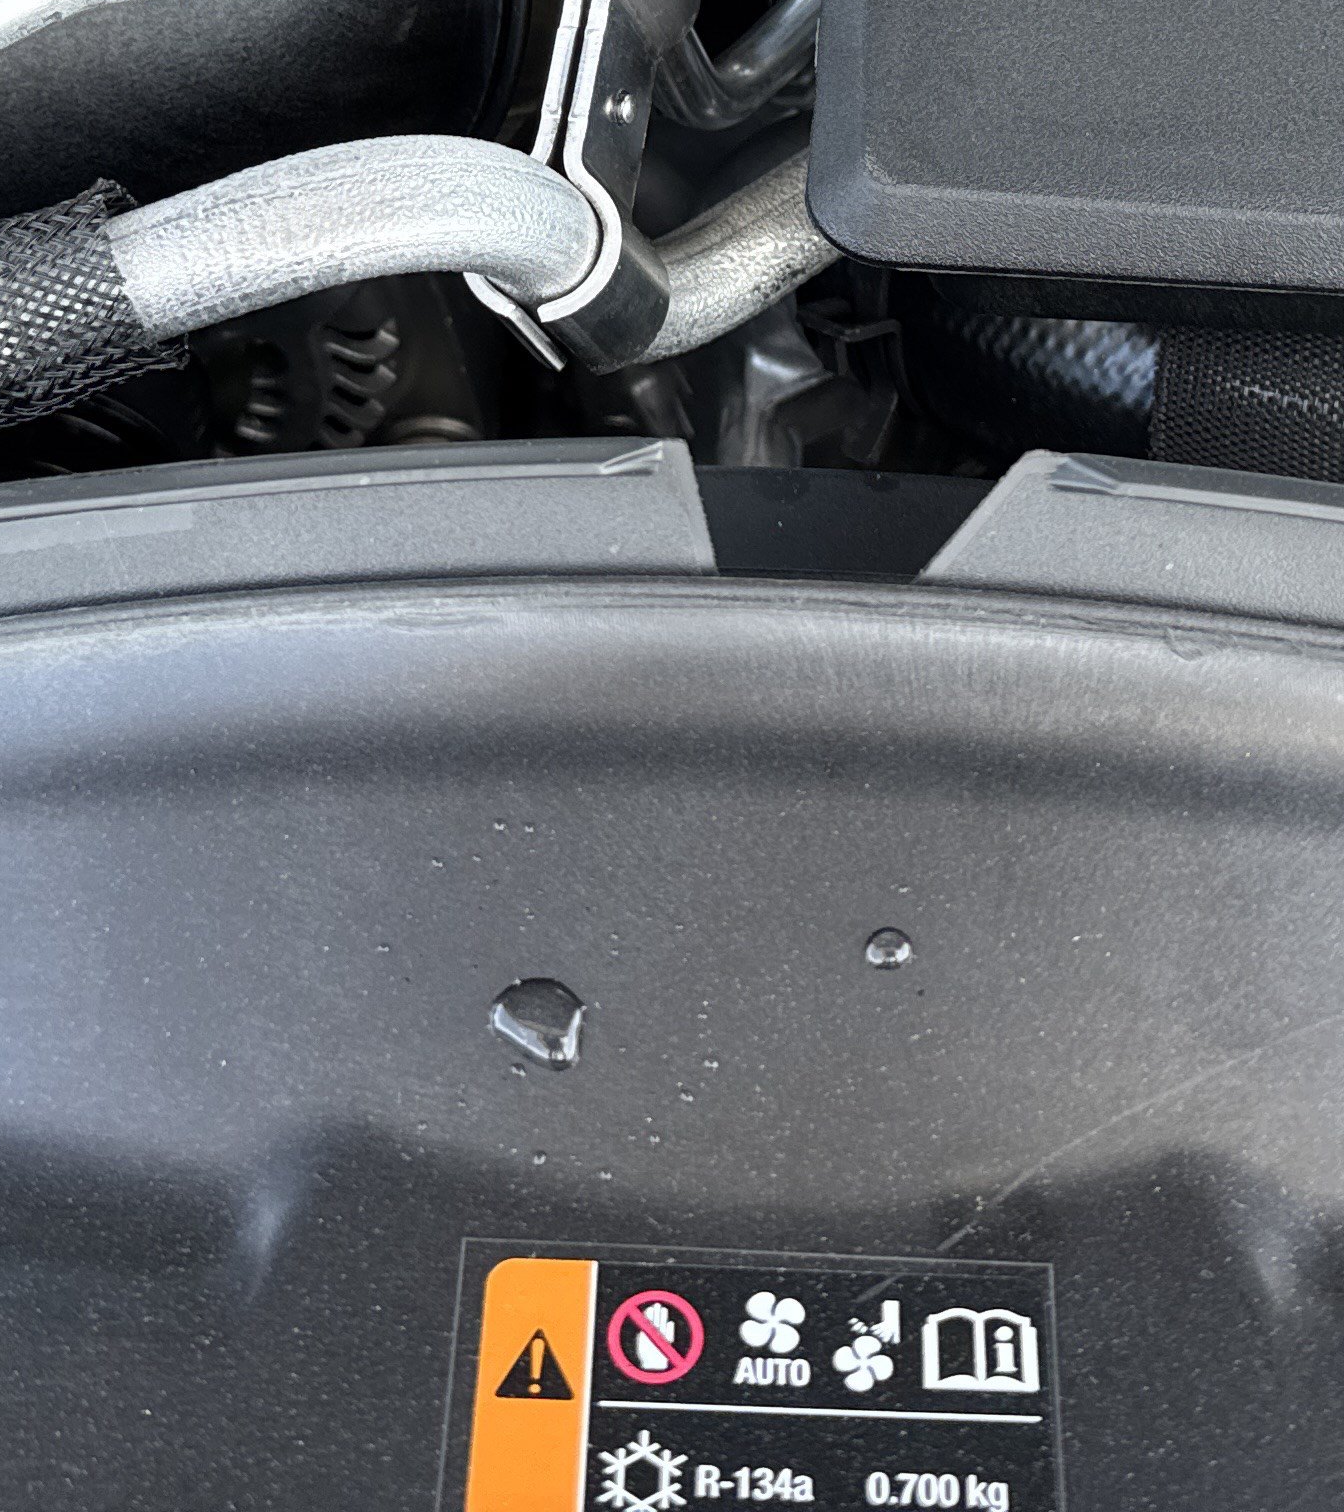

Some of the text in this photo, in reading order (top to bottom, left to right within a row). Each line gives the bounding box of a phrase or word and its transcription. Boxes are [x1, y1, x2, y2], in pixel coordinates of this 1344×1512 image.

[734, 1356, 811, 1387] AUTO
[693, 1464, 1010, 1512] R-134a 0.700 kg
